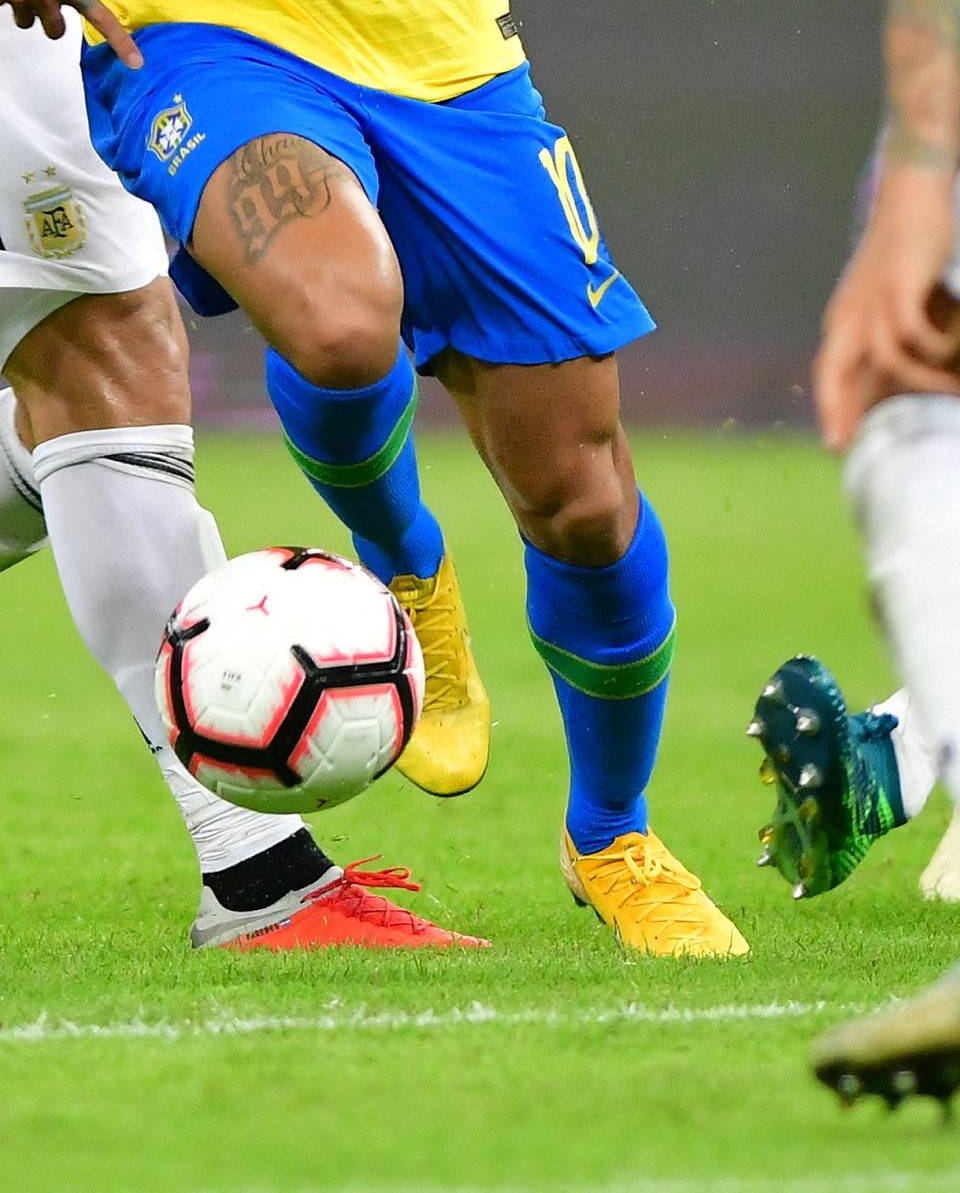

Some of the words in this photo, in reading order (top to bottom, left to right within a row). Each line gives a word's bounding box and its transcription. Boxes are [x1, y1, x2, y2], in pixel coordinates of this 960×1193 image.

[168, 132, 207, 177] BRASIL
[41, 206, 74, 238] AFA
[539, 135, 600, 265] 10
